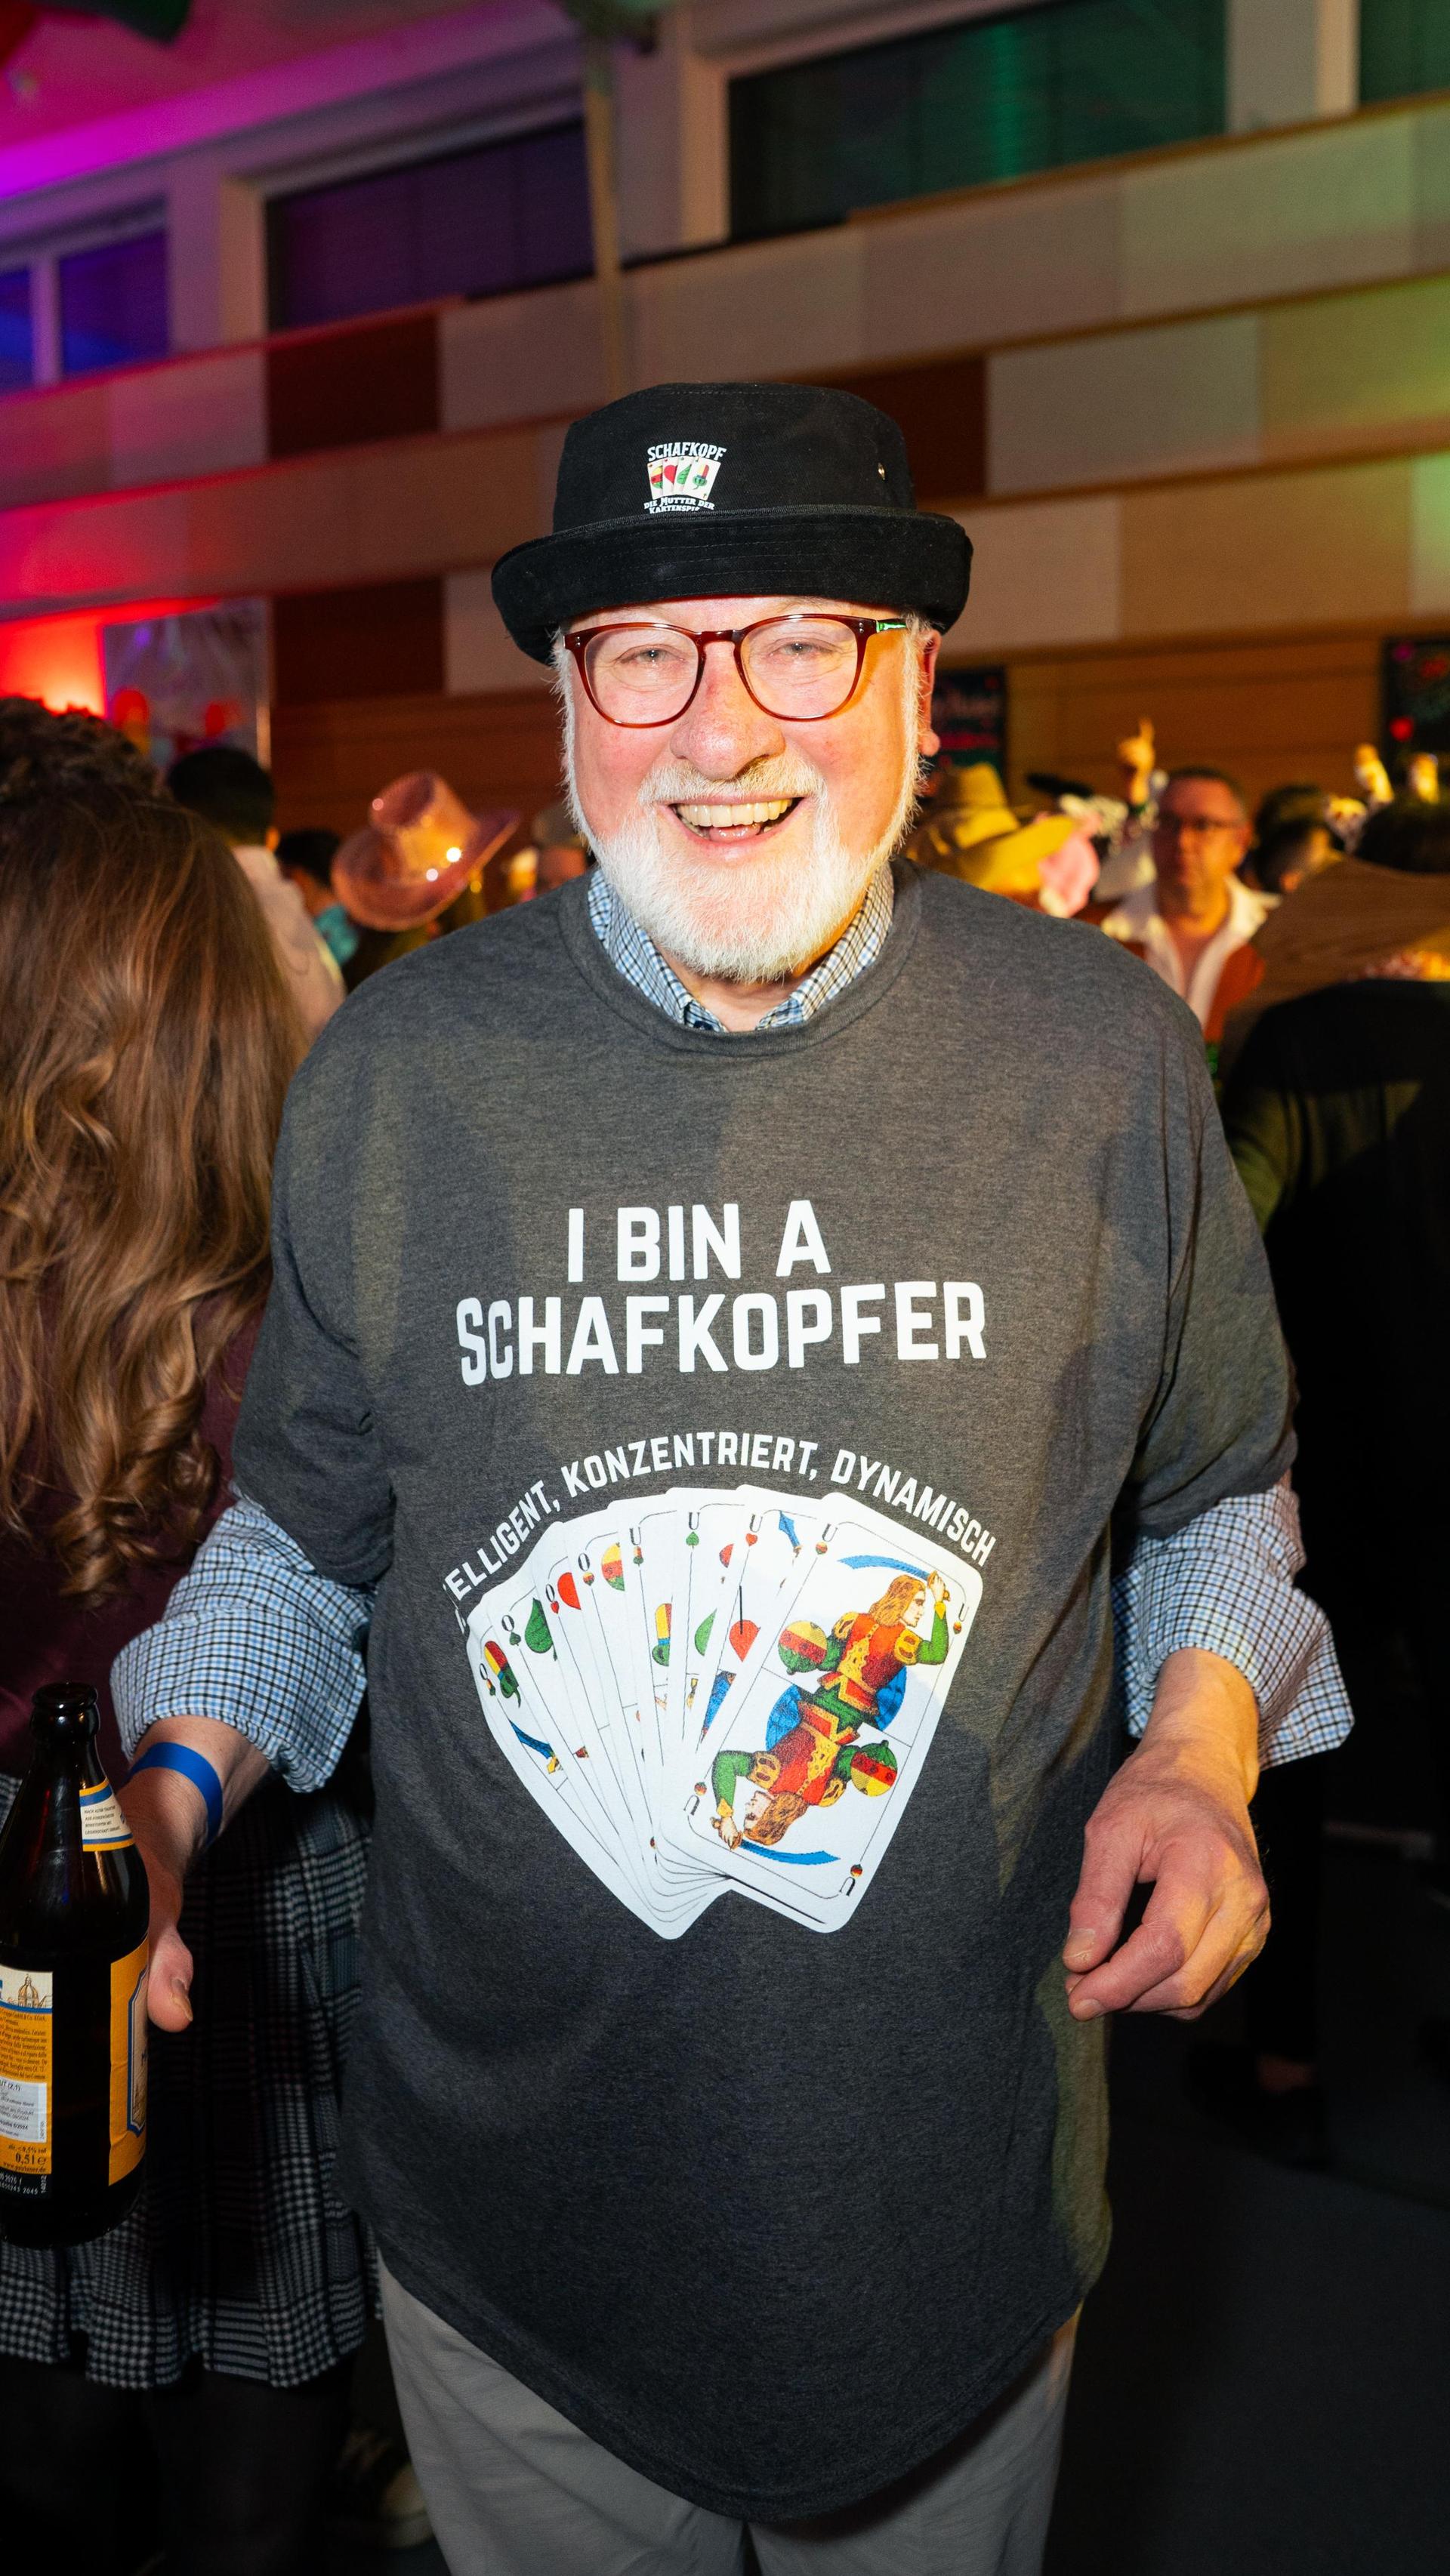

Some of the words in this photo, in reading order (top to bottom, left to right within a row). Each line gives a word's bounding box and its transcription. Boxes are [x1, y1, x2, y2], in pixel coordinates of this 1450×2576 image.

[647, 442, 727, 461] SCHAFKOPF
[643, 500, 658, 510] DIE
[659, 497, 696, 507] MUTTER
[697, 500, 715, 510] DER
[568, 1208, 584, 1283] I
[617, 1203, 741, 1282] BIN
[776, 1200, 831, 1277] A
[456, 1281, 987, 1386] SCHAFKOPFER
[561, 1431, 818, 1498] KONZENTRIERT,
[831, 1450, 996, 1567] DYNAMISCH
